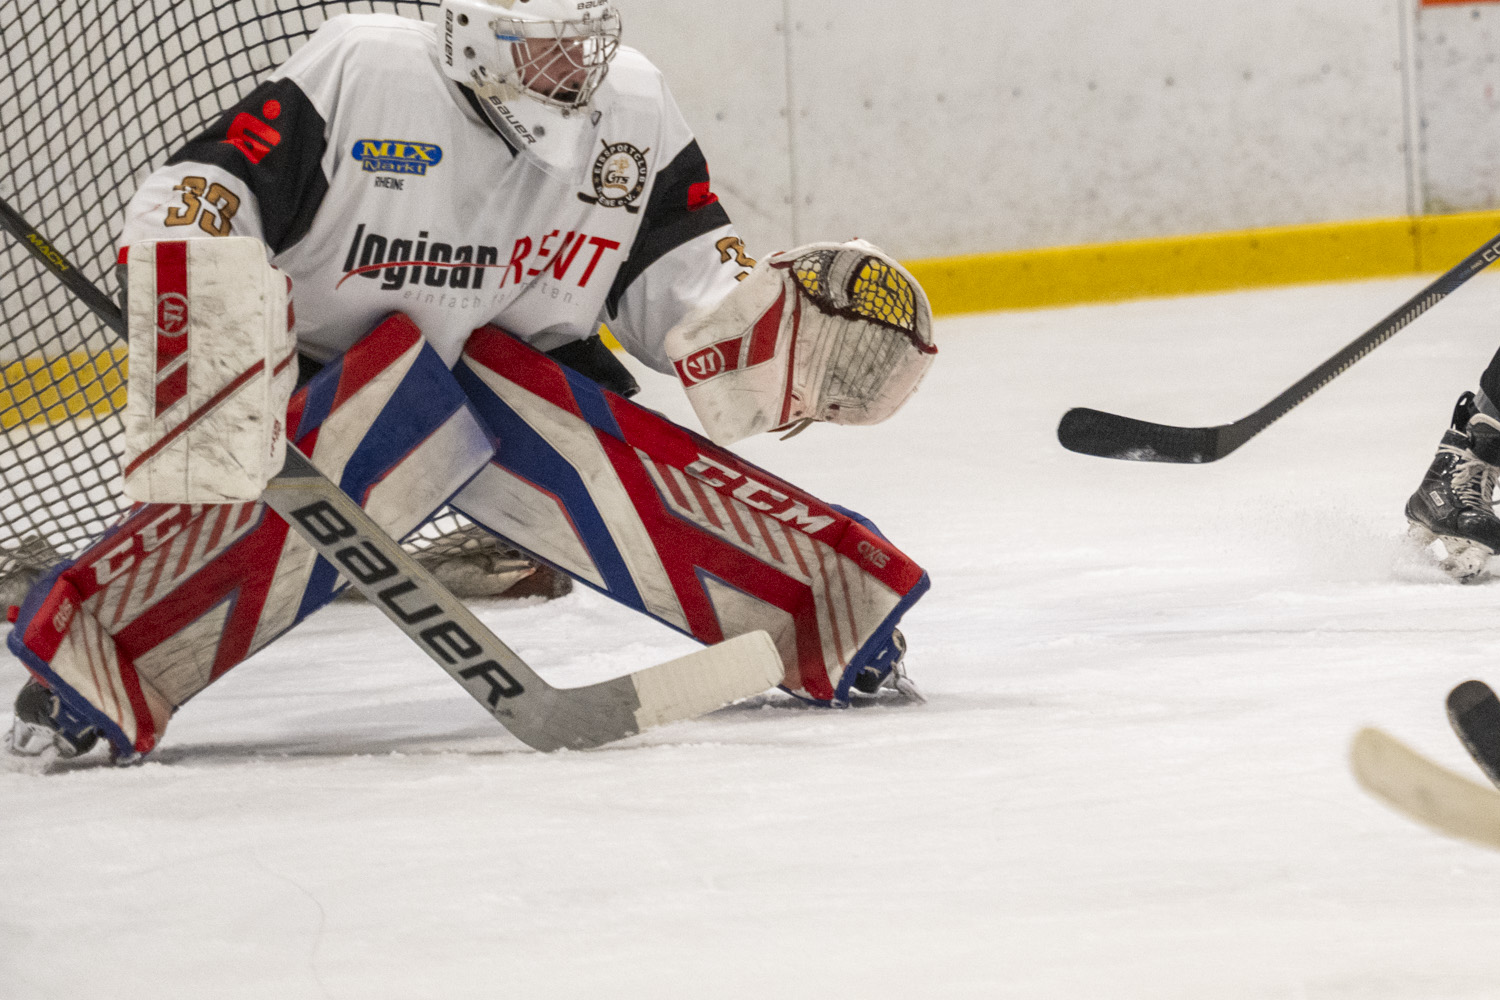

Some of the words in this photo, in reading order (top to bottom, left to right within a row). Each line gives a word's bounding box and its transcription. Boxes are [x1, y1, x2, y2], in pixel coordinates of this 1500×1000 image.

[445, 8, 454, 67] BAUER
[488, 95, 536, 145] BAUER
[361, 142, 436, 162] MIX
[364, 160, 426, 175] Markt
[164, 176, 241, 236] 33
[374, 176, 404, 190] RHEINE
[27, 233, 68, 271] MACH
[500, 229, 620, 289] RENT
[684, 452, 836, 534] CCM
[289, 500, 525, 709] BAUER
